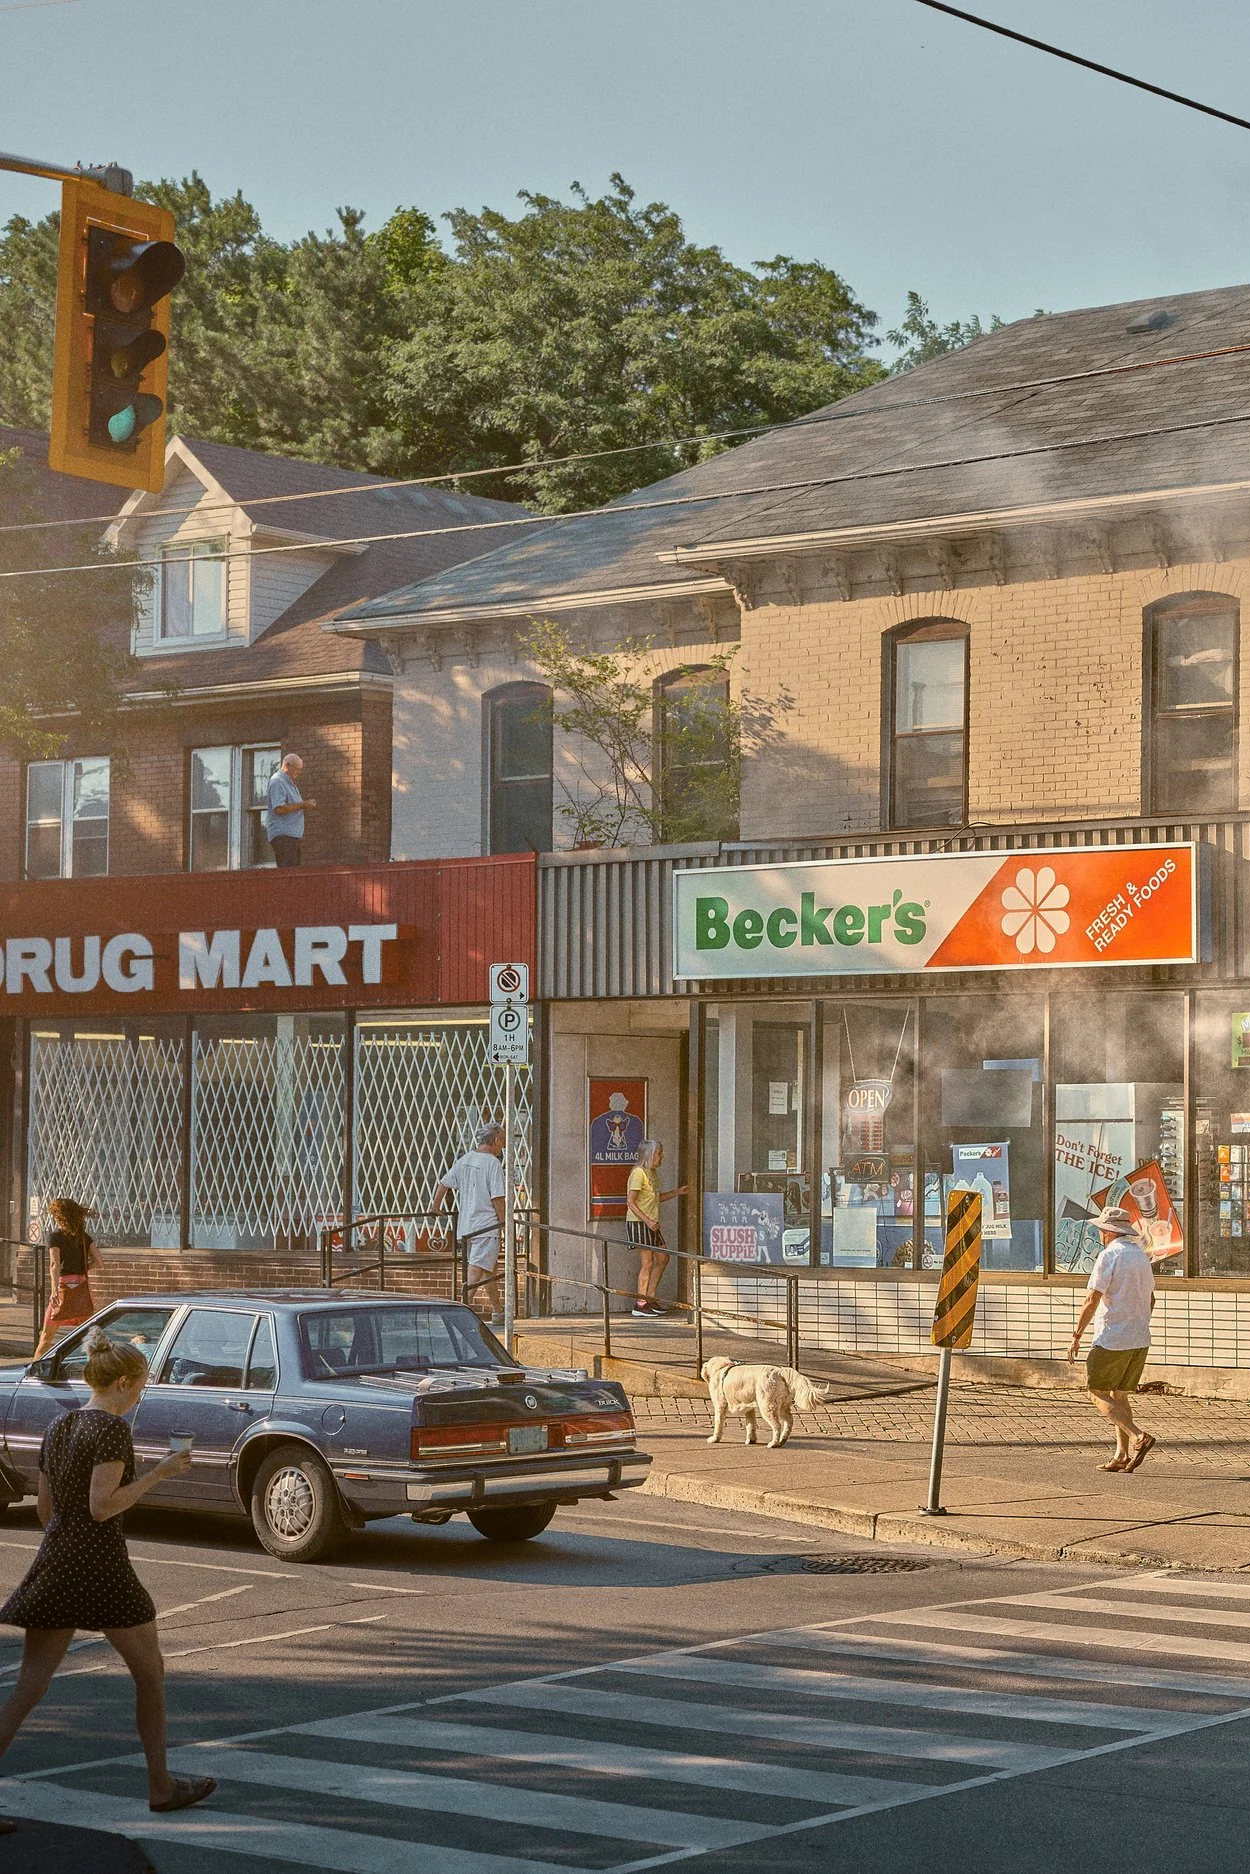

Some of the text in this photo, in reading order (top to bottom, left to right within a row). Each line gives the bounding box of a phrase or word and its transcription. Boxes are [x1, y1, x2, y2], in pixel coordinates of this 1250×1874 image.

[696, 888, 927, 950] Becker's
[1085, 881, 1138, 941] FRESH &
[1094, 858, 1176, 952] READY FOODS
[0, 923, 398, 994] RUG MART
[504, 1013, 515, 1028] P
[848, 1089, 885, 1109] OPEN
[595, 1151, 604, 1161] 4L
[605, 1151, 623, 1161] MILK
[1056, 1133, 1085, 1152] Don't
[1087, 1144, 1123, 1166] Forget
[1056, 1148, 1120, 1181] THE ICE!
[852, 1162, 884, 1176] ATM
[711, 1227, 755, 1245] SLUSH
